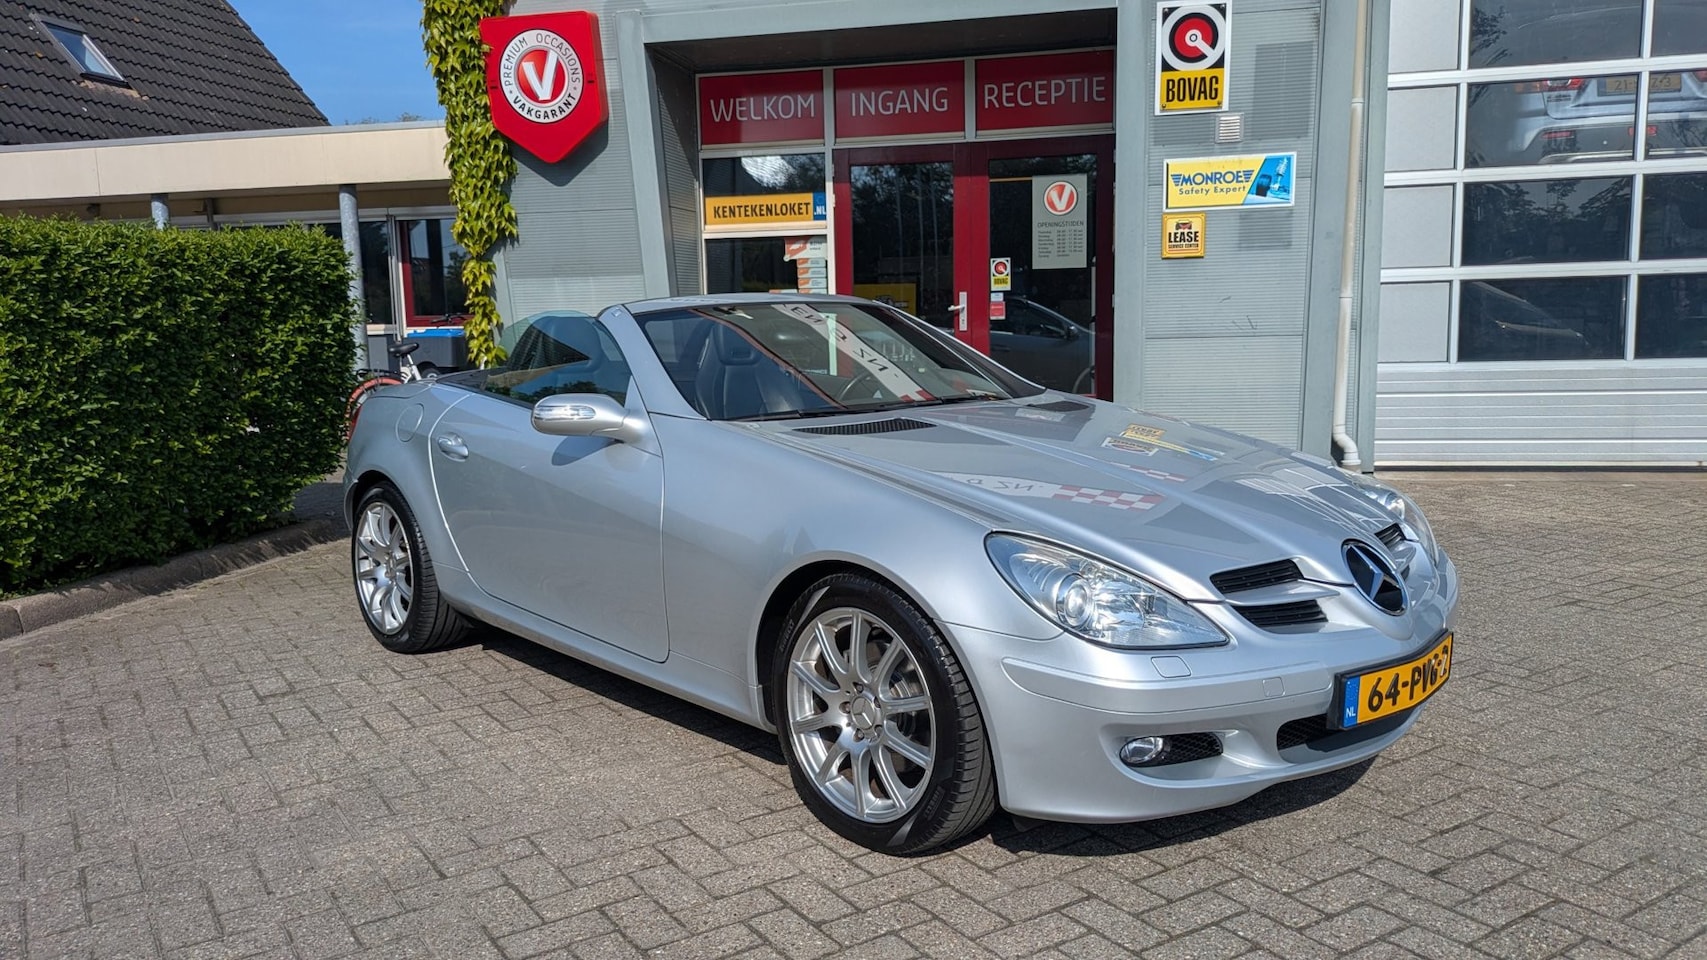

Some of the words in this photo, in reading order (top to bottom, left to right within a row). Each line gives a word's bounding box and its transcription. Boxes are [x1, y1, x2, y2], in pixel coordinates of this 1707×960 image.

[503, 37, 528, 87] PREMIUM
[536, 33, 581, 84] OCCASIONS
[851, 87, 948, 116] INGANG
[984, 76, 1106, 109] RECEPTIE
[1166, 75, 1219, 103] BOVAG
[513, 93, 577, 120] VAKGARANT
[710, 93, 815, 123] WELKOM
[1179, 187, 1210, 196] Safety
[1214, 186, 1246, 195] Expert
[1180, 170, 1243, 186] MONROE
[1168, 231, 1199, 243] LEASE
[1345, 707, 1357, 718] NL
